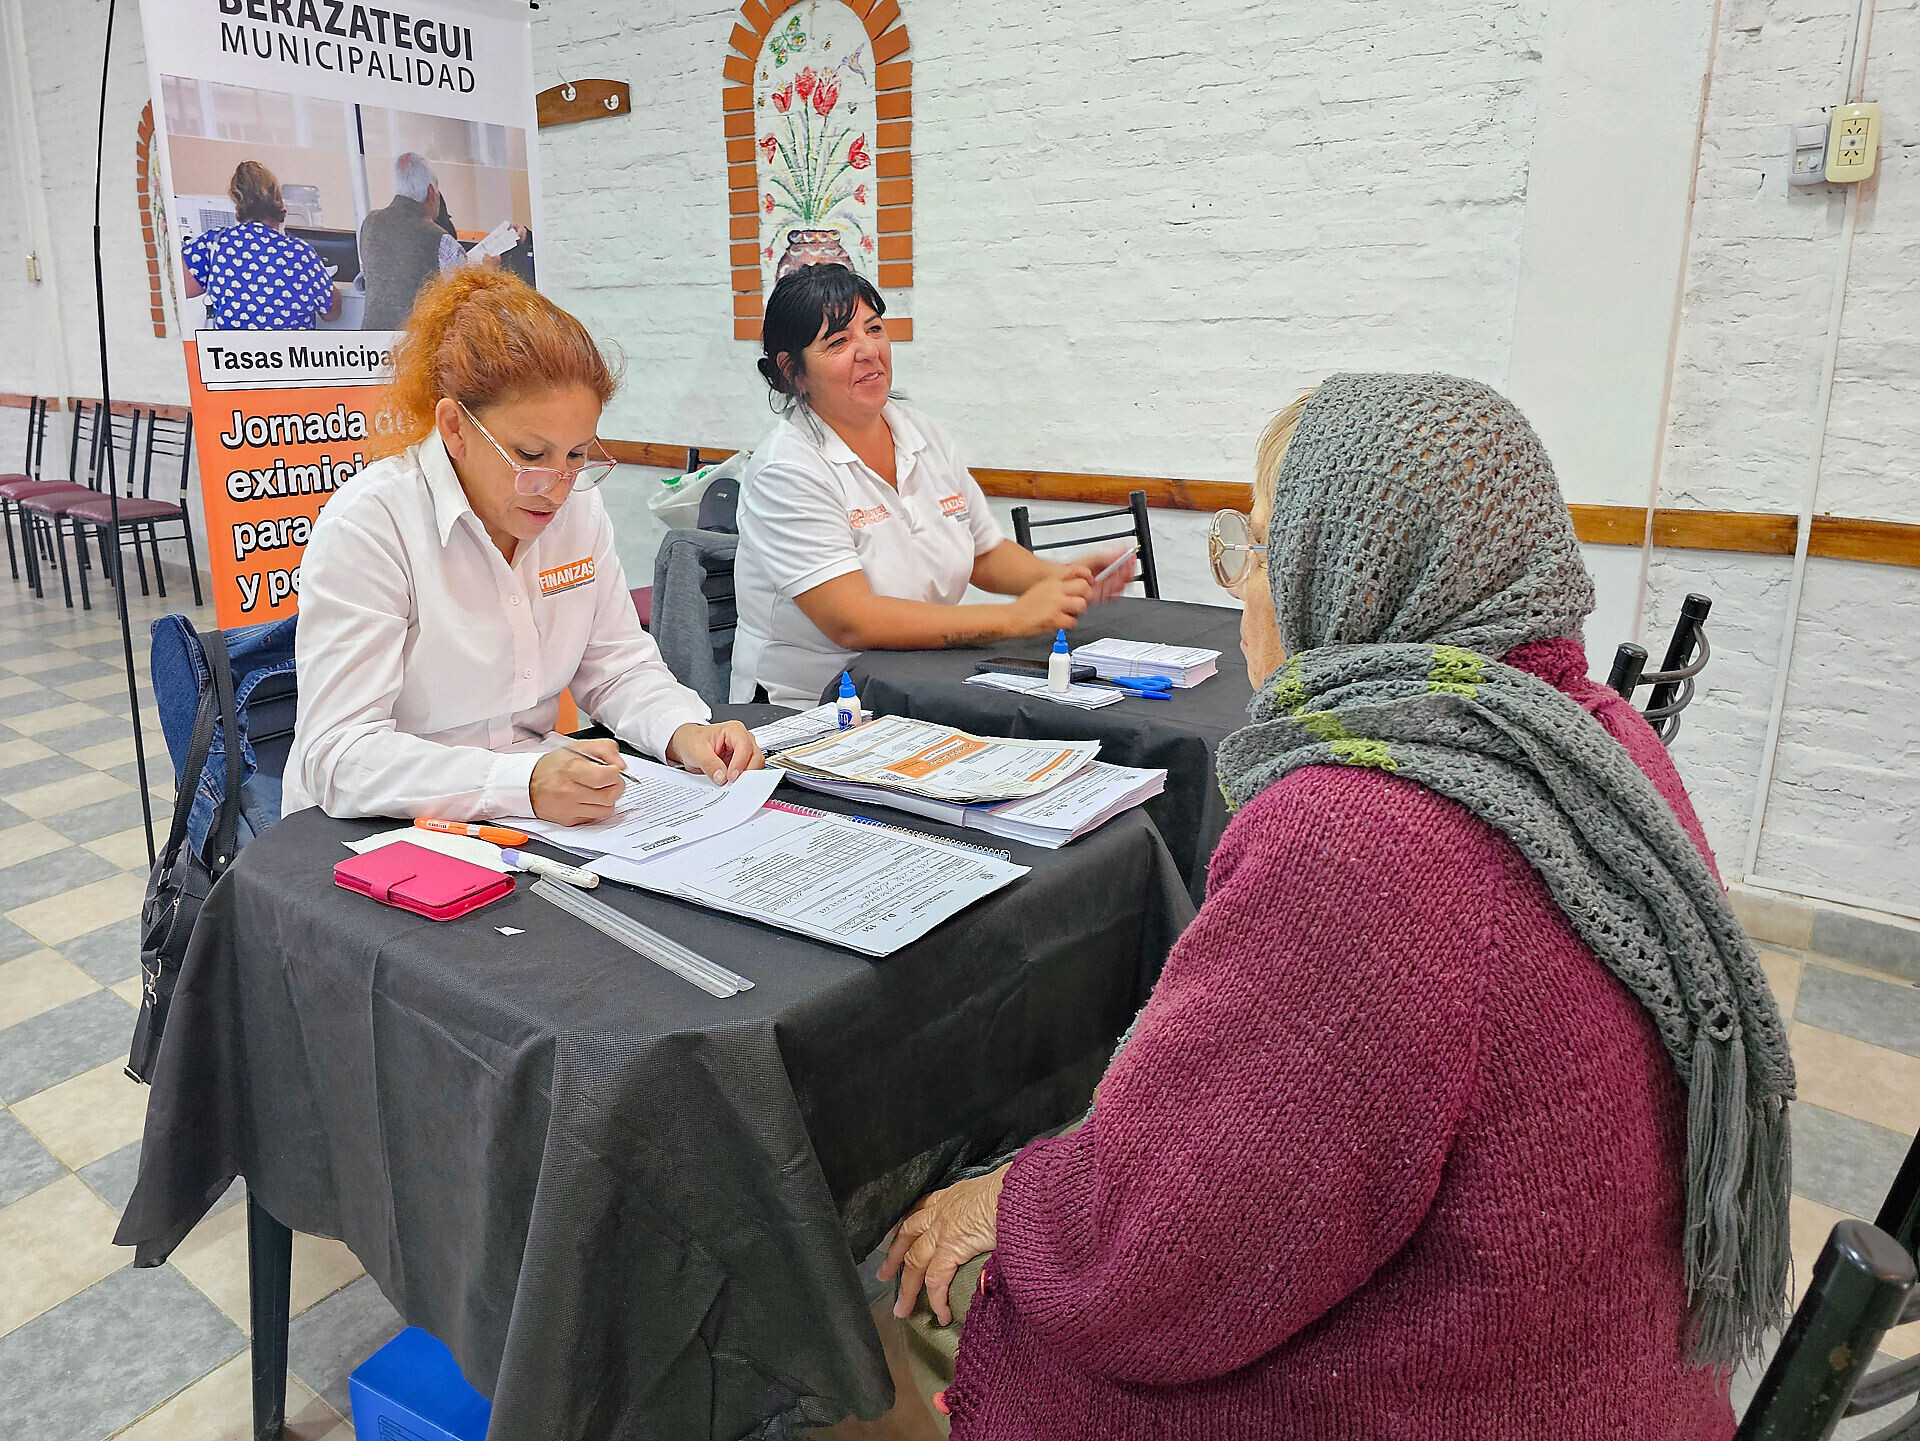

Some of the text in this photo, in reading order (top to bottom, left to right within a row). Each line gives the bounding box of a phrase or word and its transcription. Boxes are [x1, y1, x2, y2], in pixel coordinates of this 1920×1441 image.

[221, 22, 475, 93] MUNICIPALIDAD
[207, 345, 393, 371] Tasas Municipa
[221, 404, 367, 449] Jornada
[232, 516, 312, 561] para
[236, 573, 260, 612] y
[539, 560, 595, 590] FINANZAS
